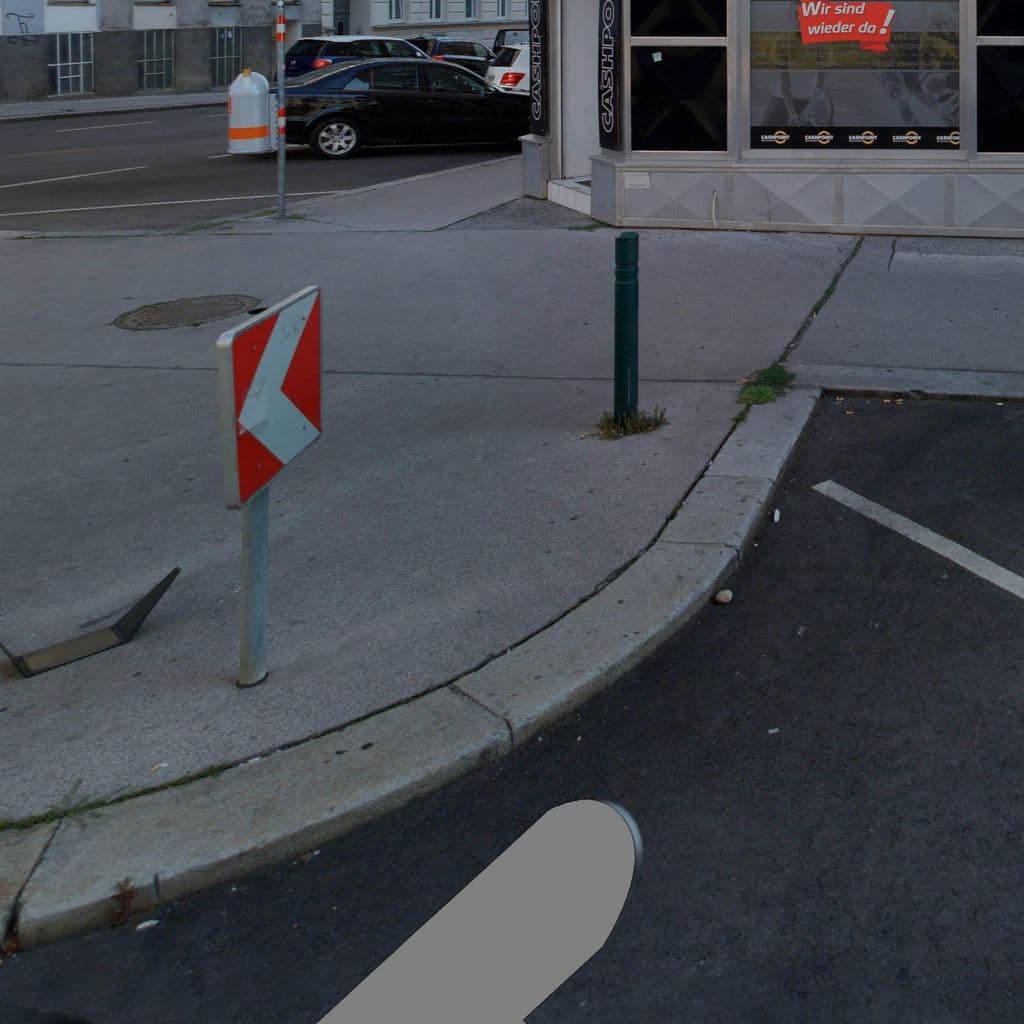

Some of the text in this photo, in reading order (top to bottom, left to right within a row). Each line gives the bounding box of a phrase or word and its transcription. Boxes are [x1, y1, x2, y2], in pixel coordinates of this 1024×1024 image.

[801, 0, 866, 17] Wir sind
[808, 22, 855, 35] wieder
